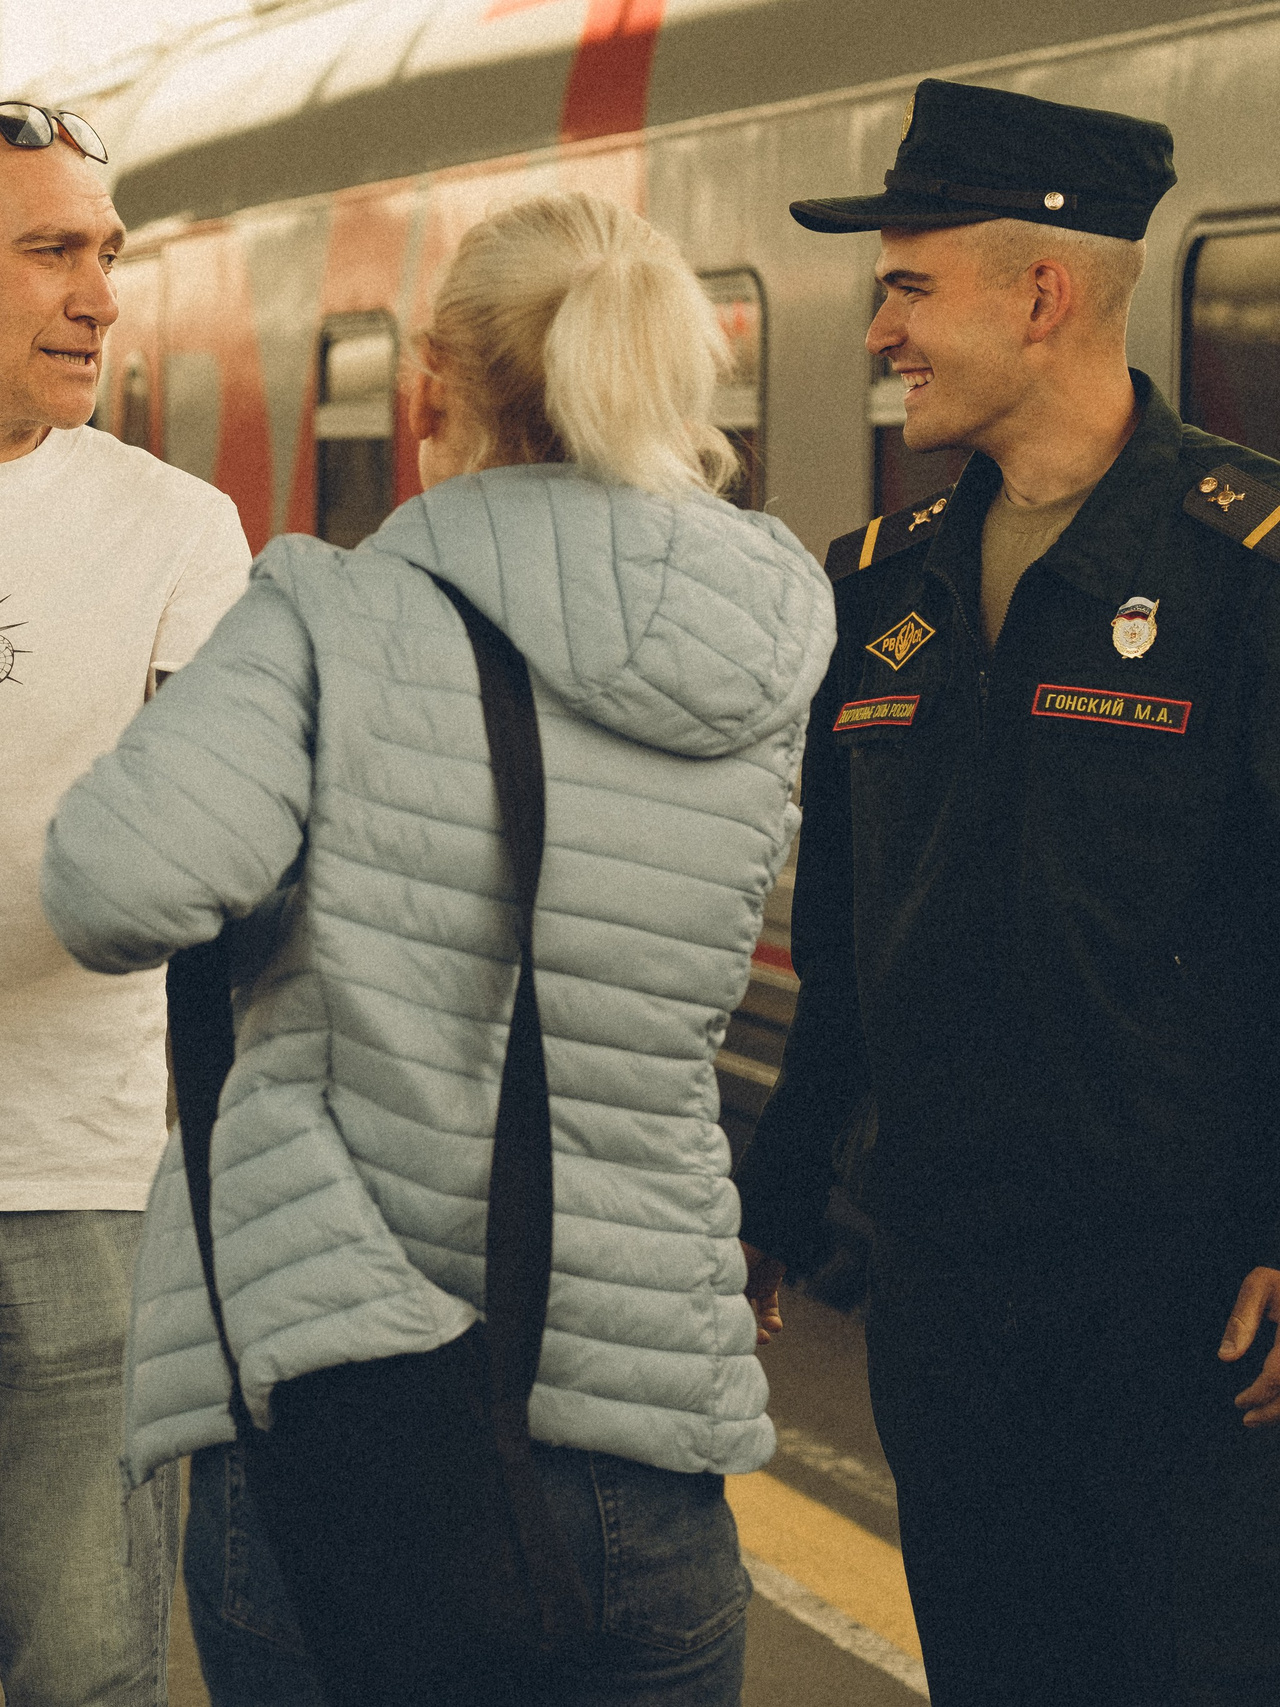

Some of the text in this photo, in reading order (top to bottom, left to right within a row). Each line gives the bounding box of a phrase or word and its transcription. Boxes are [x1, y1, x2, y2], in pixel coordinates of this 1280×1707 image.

[882, 637, 896, 652] РВ
[872, 703, 891, 718] СИЛЫ
[1045, 693, 1173, 724] ГОНСКИЙ М.А.
